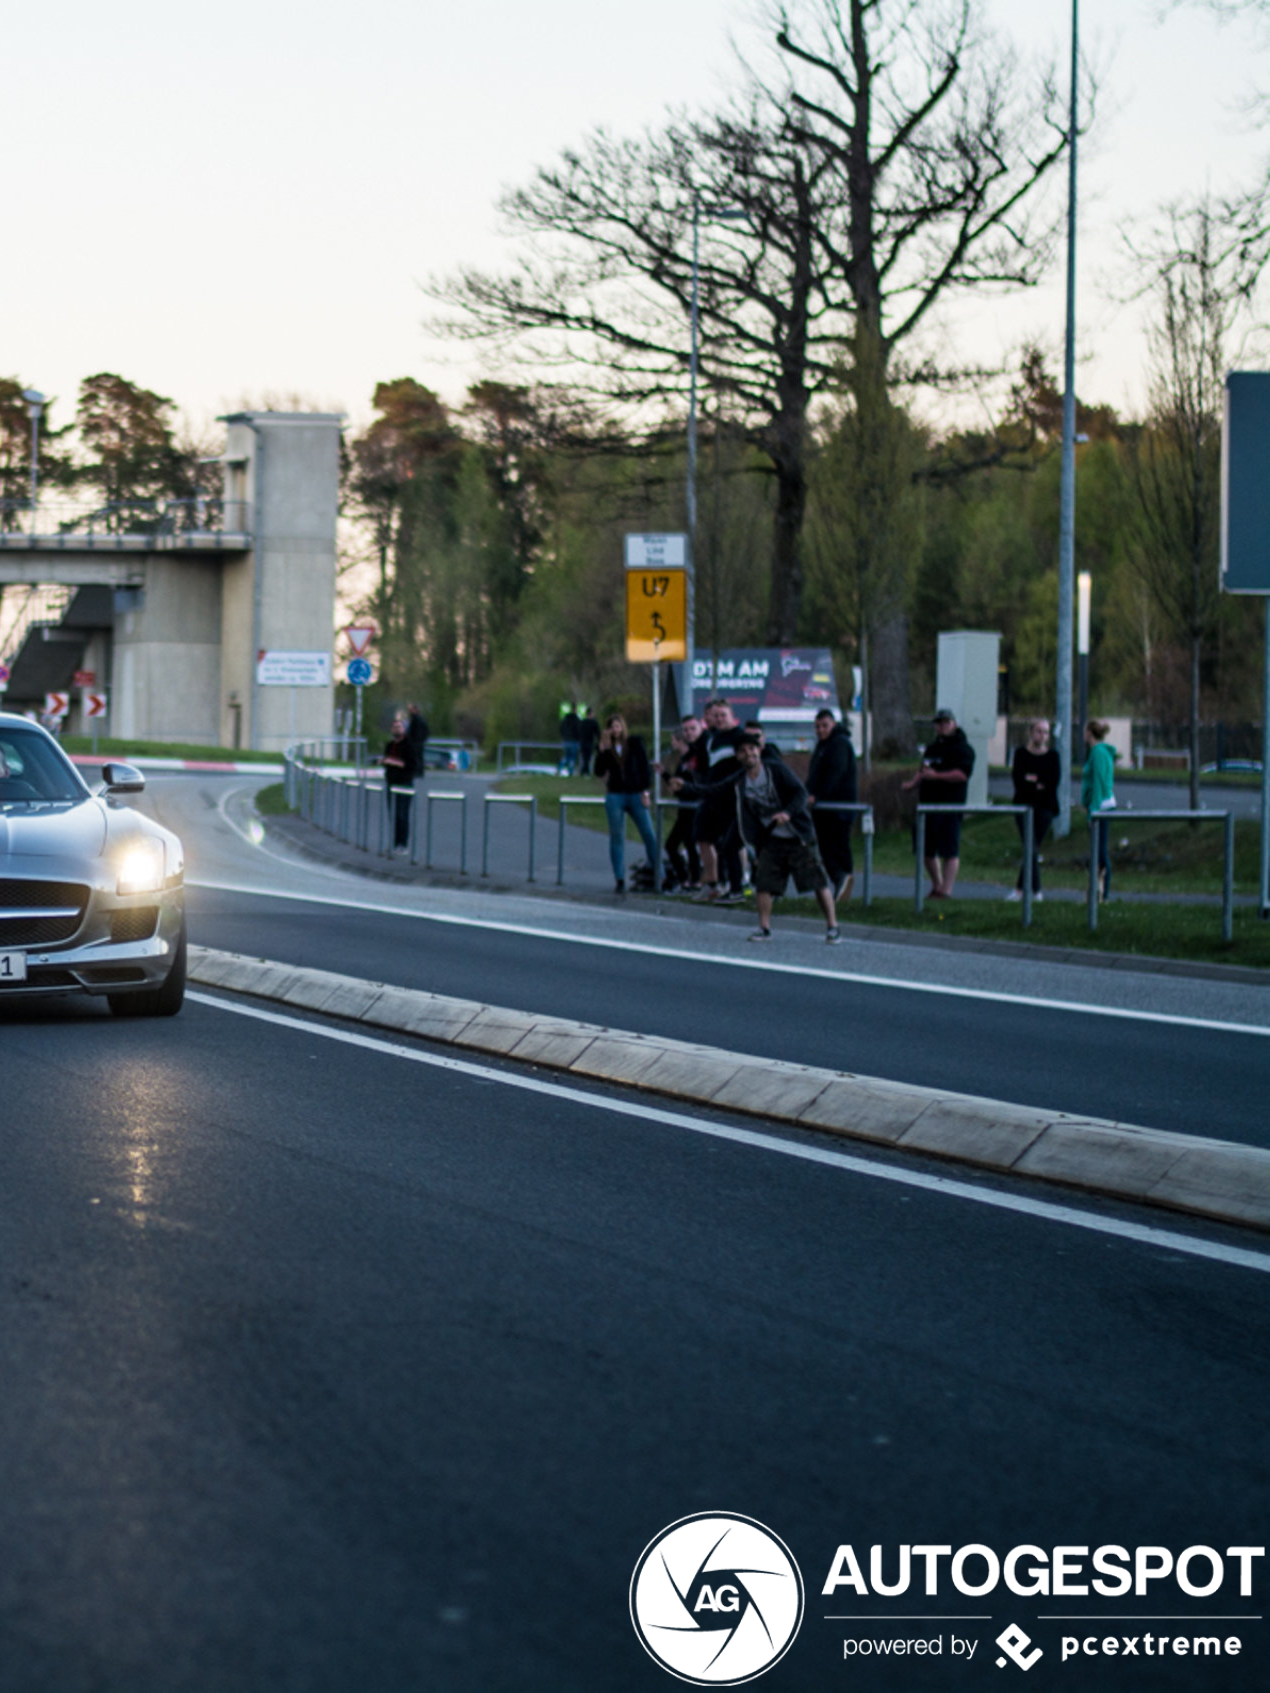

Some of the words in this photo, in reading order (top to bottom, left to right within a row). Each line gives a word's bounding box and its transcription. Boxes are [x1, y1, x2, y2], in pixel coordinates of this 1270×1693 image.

[642, 576, 670, 598] U7
[693, 660, 734, 678] DTM
[738, 660, 770, 678] AM
[1, 956, 13, 976] 1
